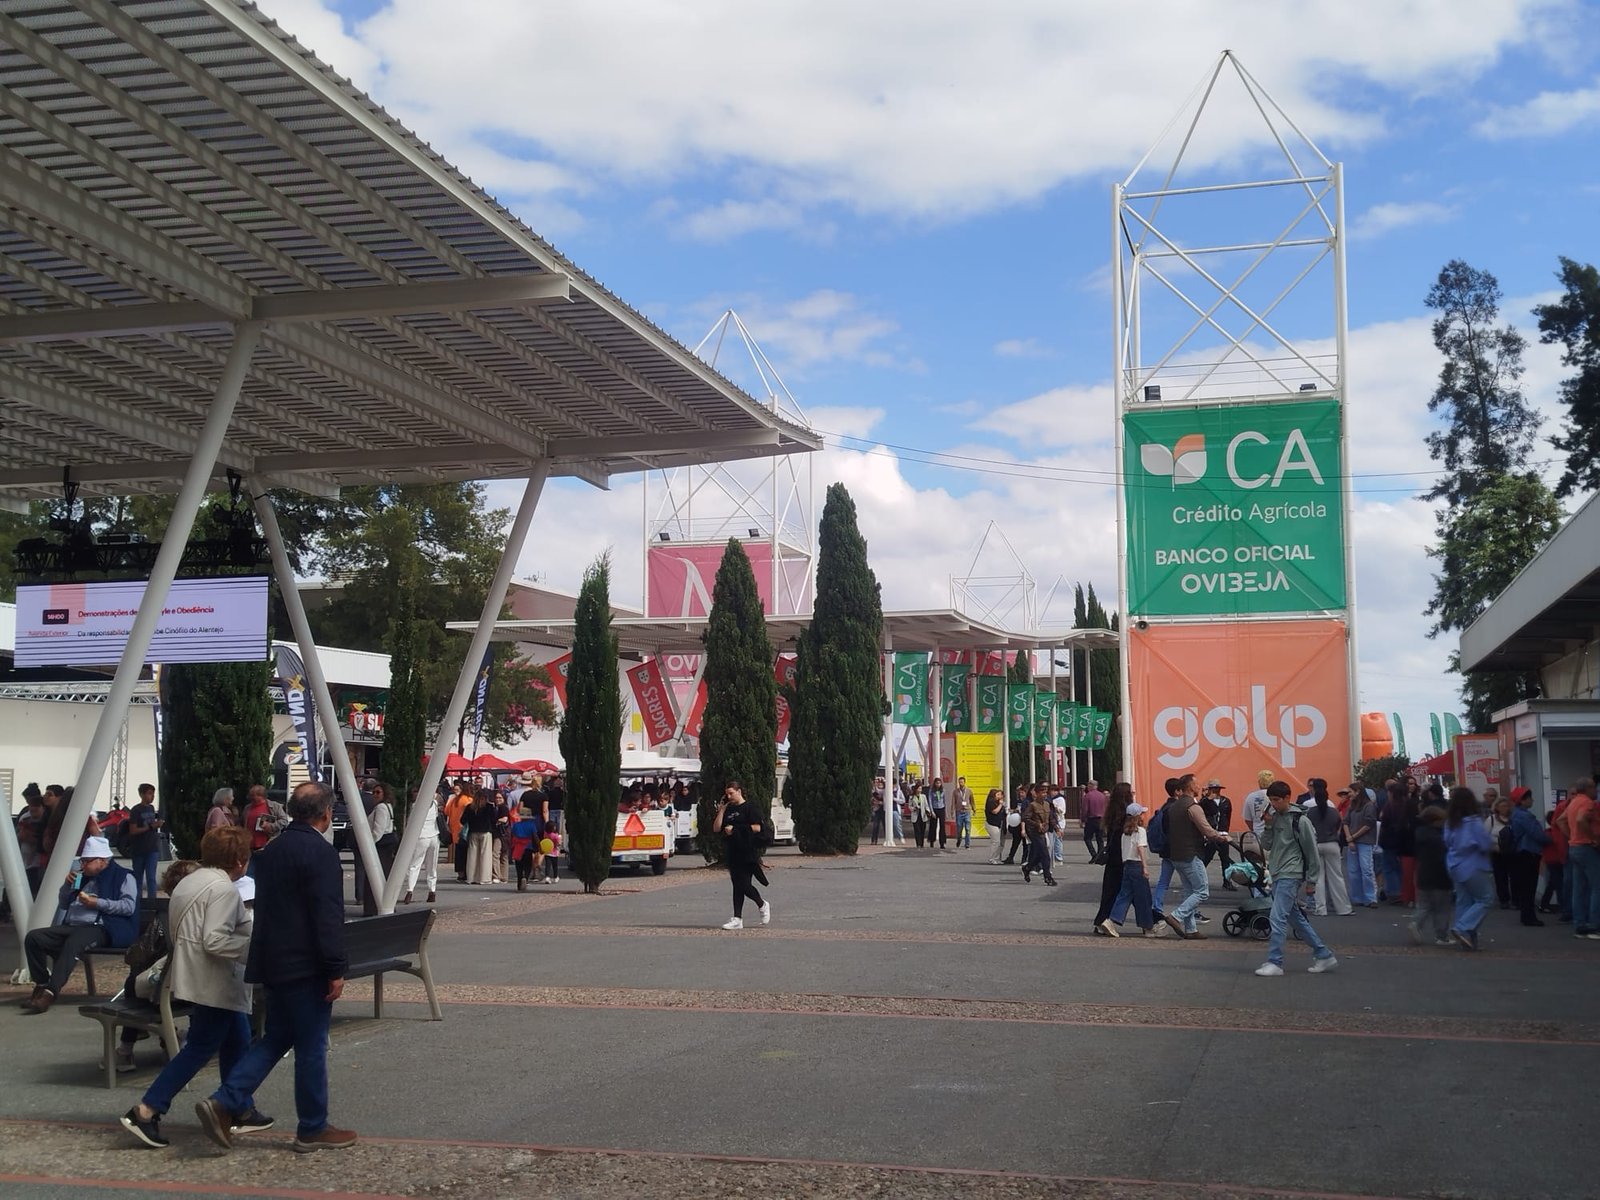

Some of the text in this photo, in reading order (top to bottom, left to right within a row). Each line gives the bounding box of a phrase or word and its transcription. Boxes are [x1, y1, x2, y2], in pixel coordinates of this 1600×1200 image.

[1226, 428, 1325, 489] CA
[1172, 500, 1327, 524] Crédito Agrícola
[1155, 543, 1315, 566] BANCO OFICIAL
[1180, 569, 1290, 594] OVIBEJA
[78, 610, 129, 619] Demonstrações
[176, 606, 214, 615] Obediência
[87, 629, 131, 638] responsabilida
[198, 626, 224, 635] Alentejo
[898, 662, 917, 690] CA
[982, 683, 997, 705] CA
[1013, 690, 1027, 711] CA
[641, 686, 673, 739] SAGRES
[1039, 699, 1052, 718] CA
[1061, 707, 1073, 725] CA
[1079, 711, 1091, 729] CA
[1095, 717, 1106, 733] CA
[1153, 685, 1328, 770] galp
